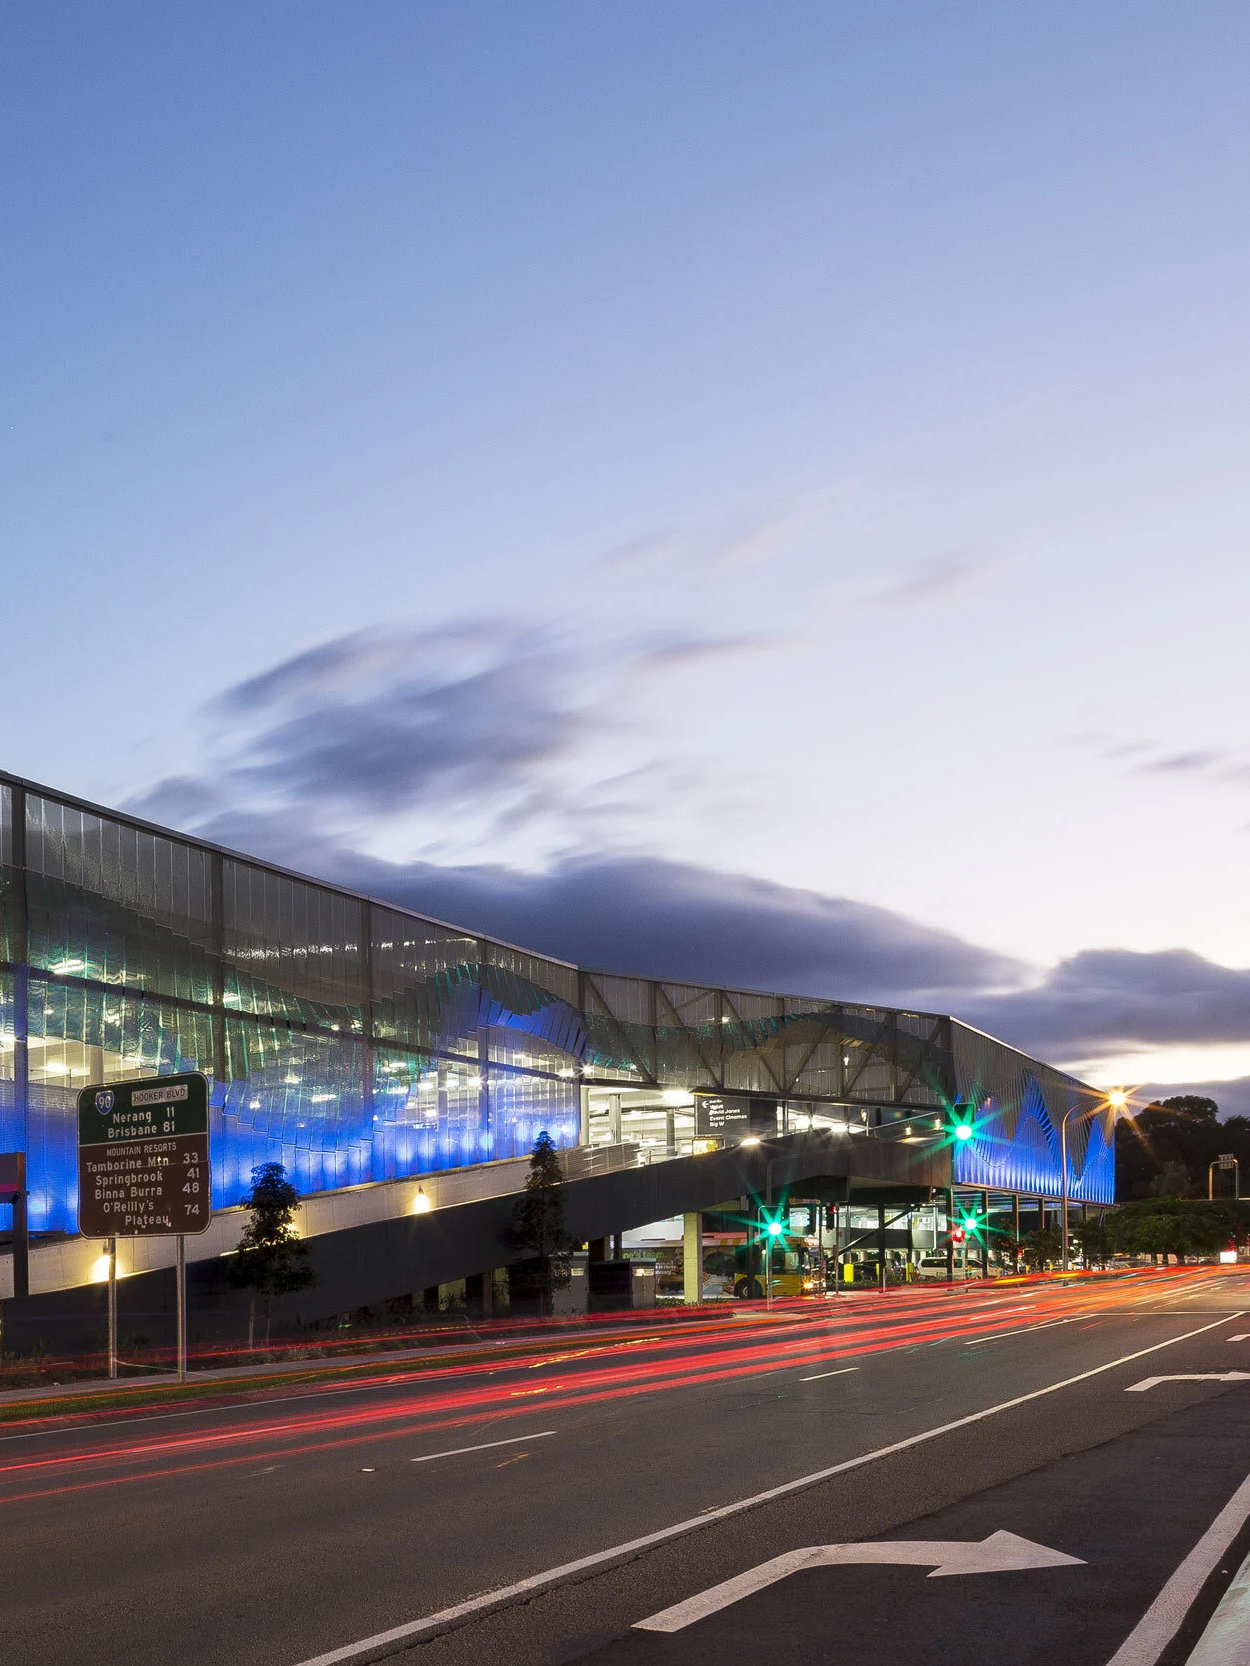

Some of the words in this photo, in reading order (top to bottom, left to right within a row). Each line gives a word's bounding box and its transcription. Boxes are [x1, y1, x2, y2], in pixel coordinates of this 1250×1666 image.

[133, 1091, 163, 1102] HOOKER
[166, 1088, 186, 1099] BLVD
[113, 1111, 152, 1124] Nerang
[166, 1106, 175, 1118] 11
[108, 1124, 157, 1138] Brisbane
[163, 1120, 175, 1132] 81
[106, 1145, 142, 1157] MOUNTAIN
[143, 1142, 177, 1153] RESORTS
[86, 1159, 142, 1173] Tamborine
[147, 1155, 169, 1167] Mtn
[183, 1152, 198, 1164] 33
[95, 1171, 163, 1187] Springbrook
[187, 1167, 200, 1179] 41
[95, 1189, 125, 1200] Binna
[130, 1186, 163, 1198] Burra
[182, 1182, 200, 1194] 48
[103, 1200, 154, 1213] O'Reilly's
[125, 1214, 169, 1226] Plateau
[184, 1204, 200, 1215] 74
